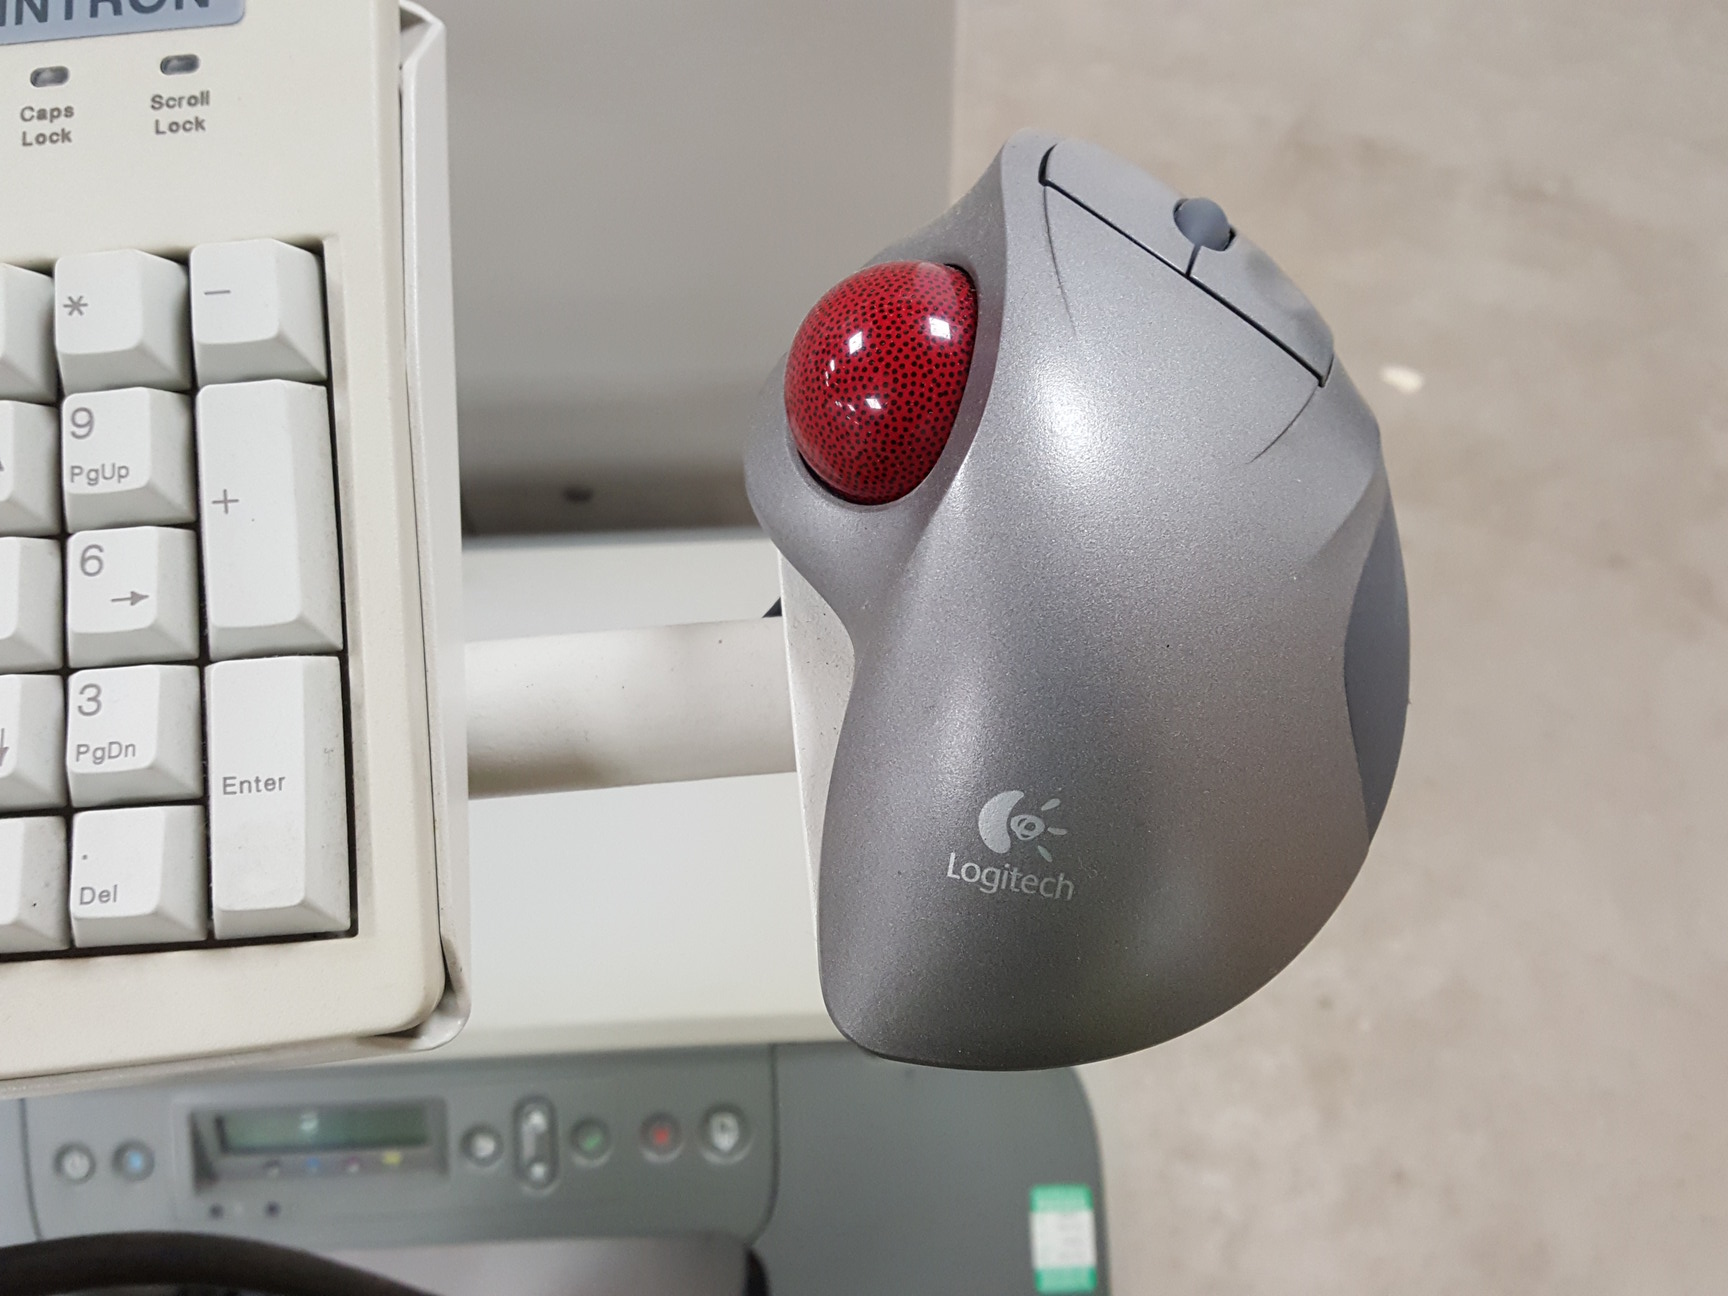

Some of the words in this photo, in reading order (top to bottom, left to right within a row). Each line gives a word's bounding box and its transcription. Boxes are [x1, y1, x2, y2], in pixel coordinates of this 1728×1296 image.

[150, 90, 210, 111] Scroll
[20, 105, 75, 124] Caps
[154, 116, 206, 135] Lock
[21, 127, 73, 147] Lock
[70, 406, 95, 440] 9
[70, 462, 130, 487] PgUp
[211, 488, 240, 515] +
[79, 543, 104, 578] 6
[77, 683, 102, 717] 3
[75, 740, 136, 766] PgDn
[222, 774, 286, 796] Enter
[947, 851, 1075, 901] Logitech
[79, 884, 118, 906] Del
